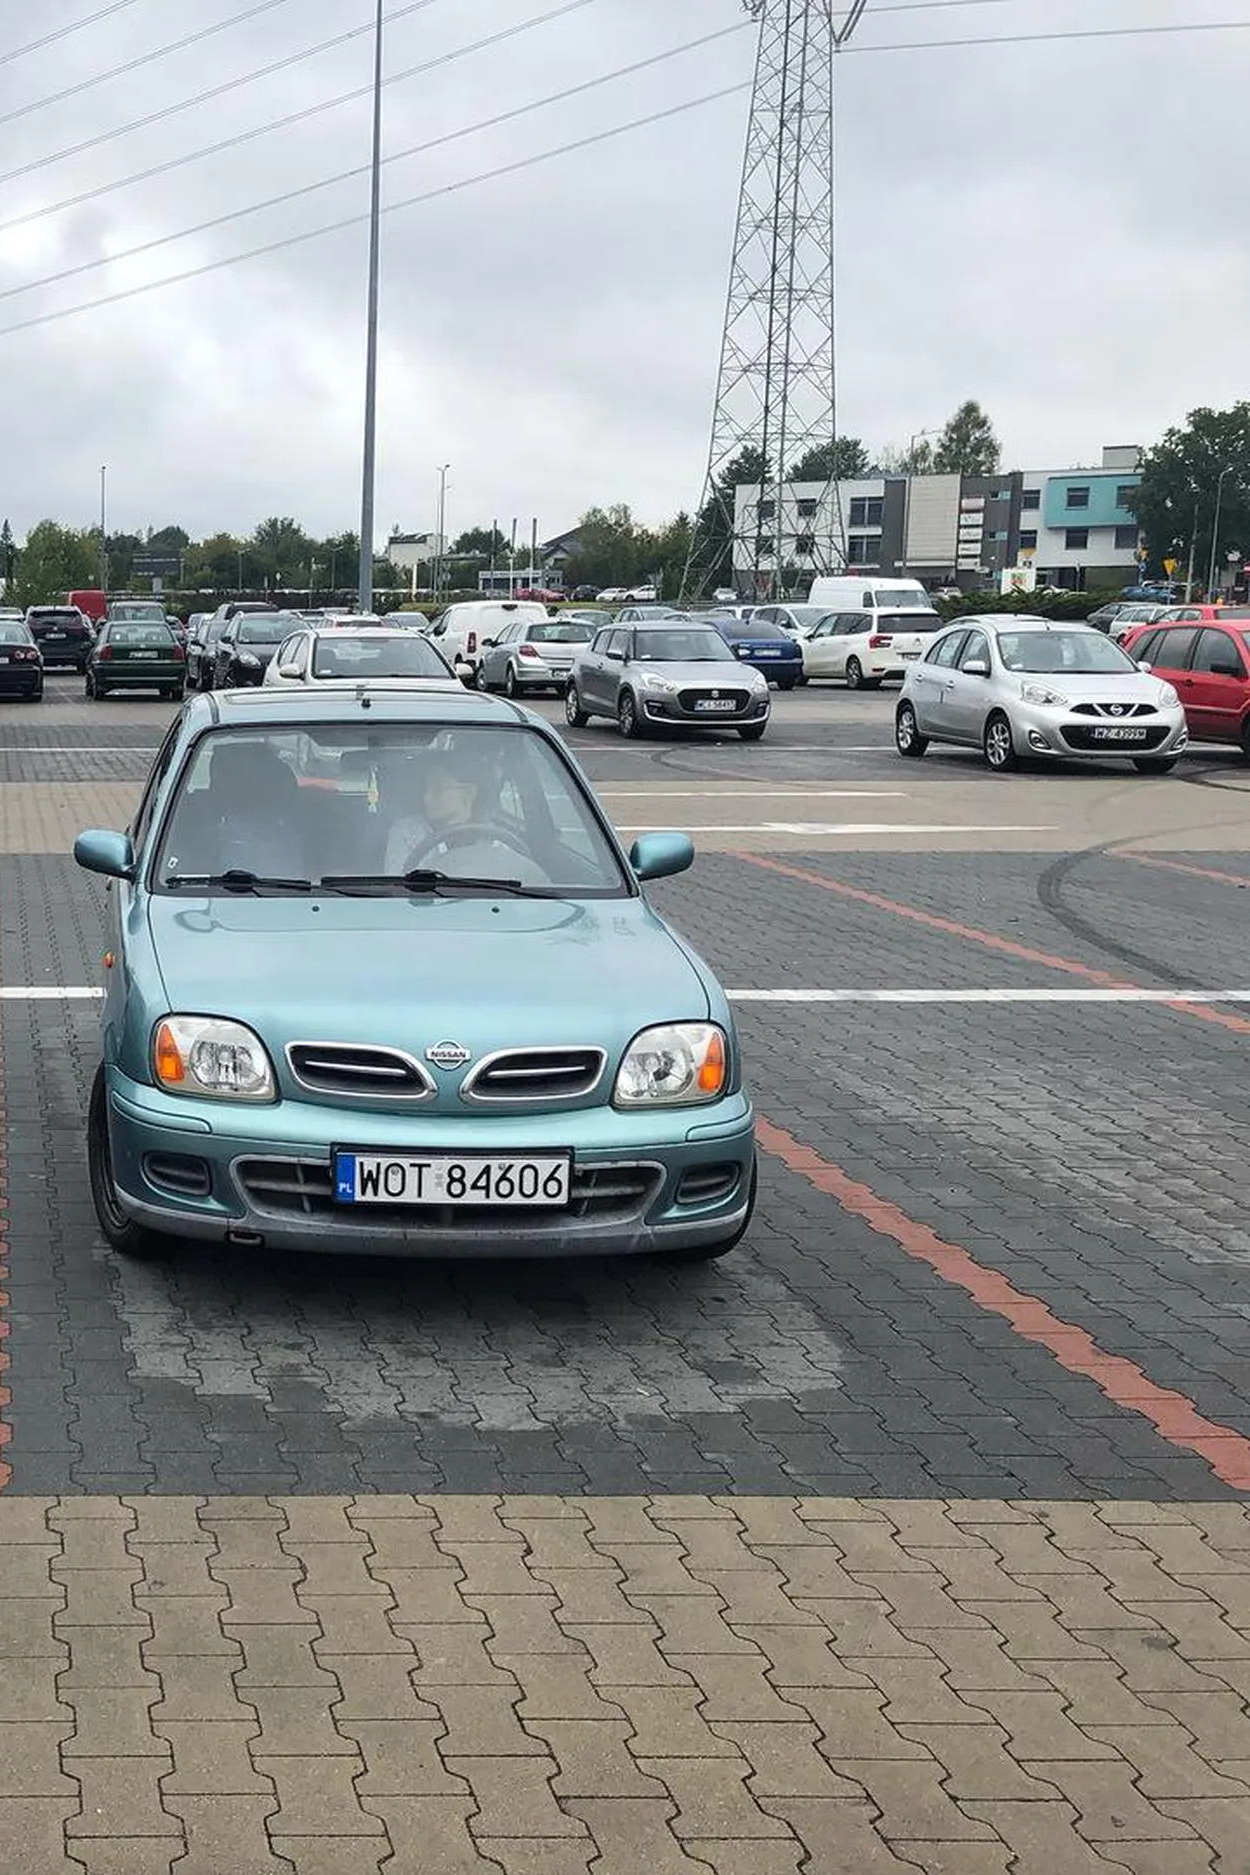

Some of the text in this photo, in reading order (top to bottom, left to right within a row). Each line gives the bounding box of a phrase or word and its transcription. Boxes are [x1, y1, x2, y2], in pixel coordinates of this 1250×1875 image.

[338, 1161, 563, 1199] PL WOT 84606
